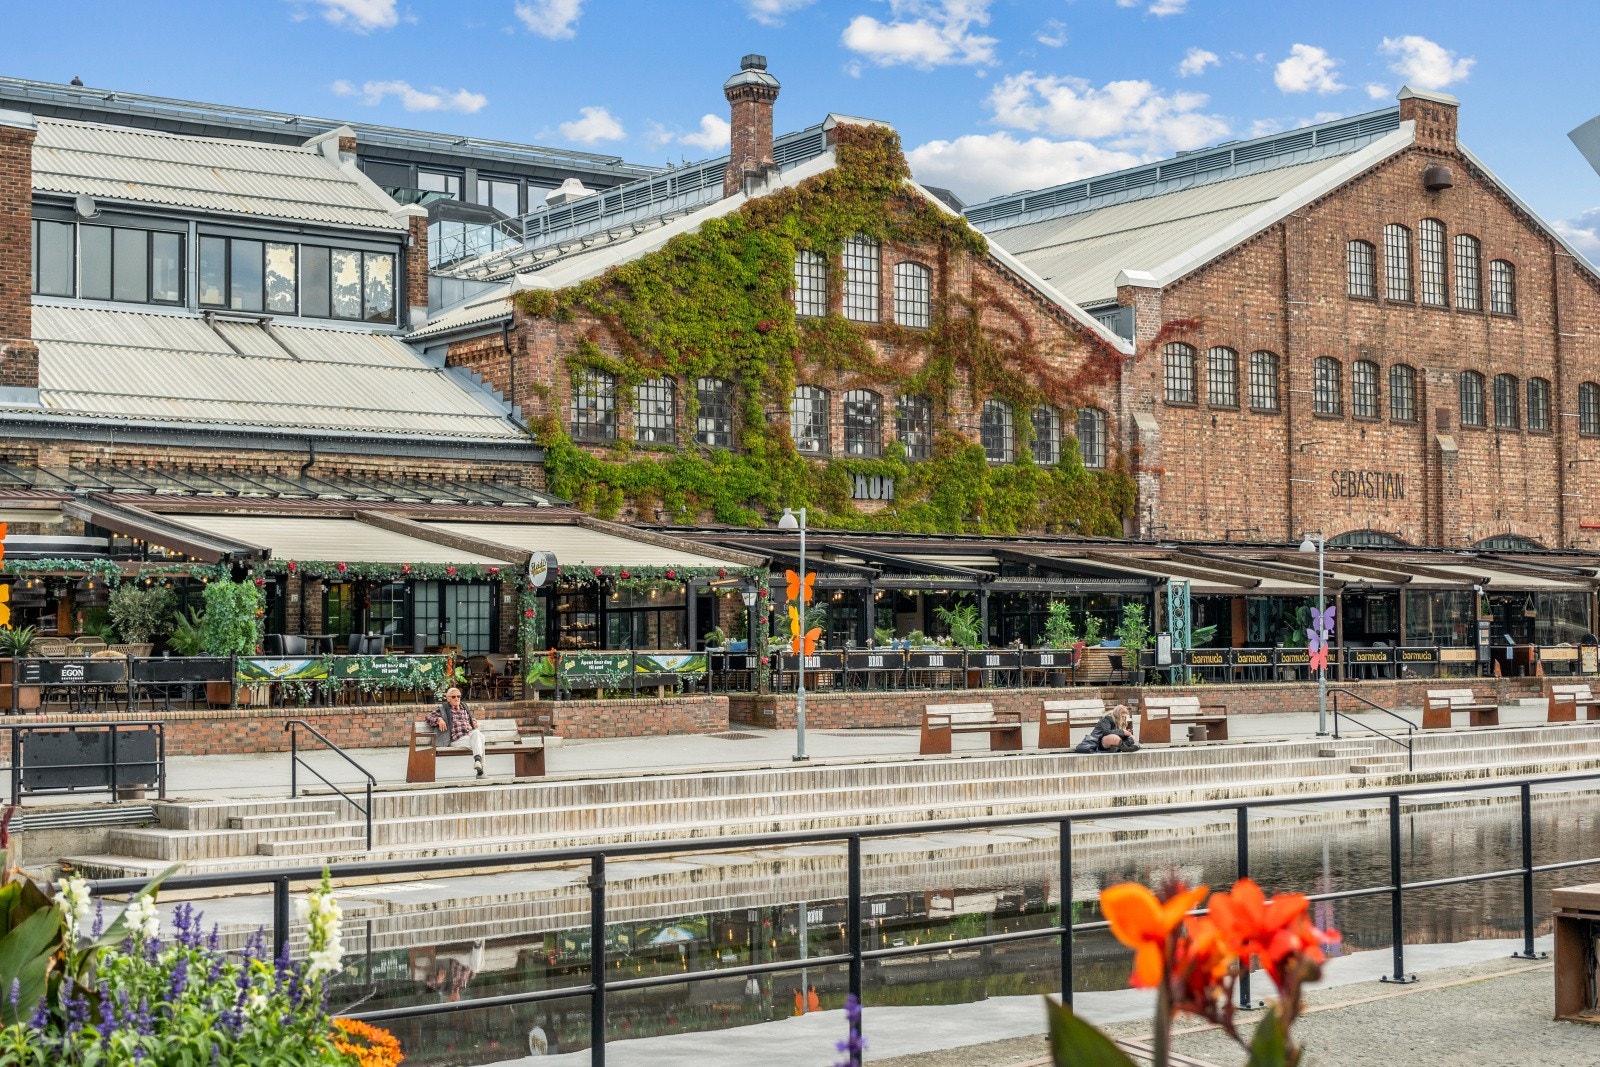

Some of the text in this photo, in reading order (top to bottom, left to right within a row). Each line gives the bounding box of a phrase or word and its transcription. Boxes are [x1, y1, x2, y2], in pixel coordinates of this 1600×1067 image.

[1331, 469, 1404, 499] SEBASTIAN
[1191, 653, 1223, 664] barmuda
[1237, 653, 1267, 663] barmuda
[1281, 652, 1309, 662] barmuda
[1356, 651, 1387, 661] barmuda
[1402, 651, 1431, 660] barmuda
